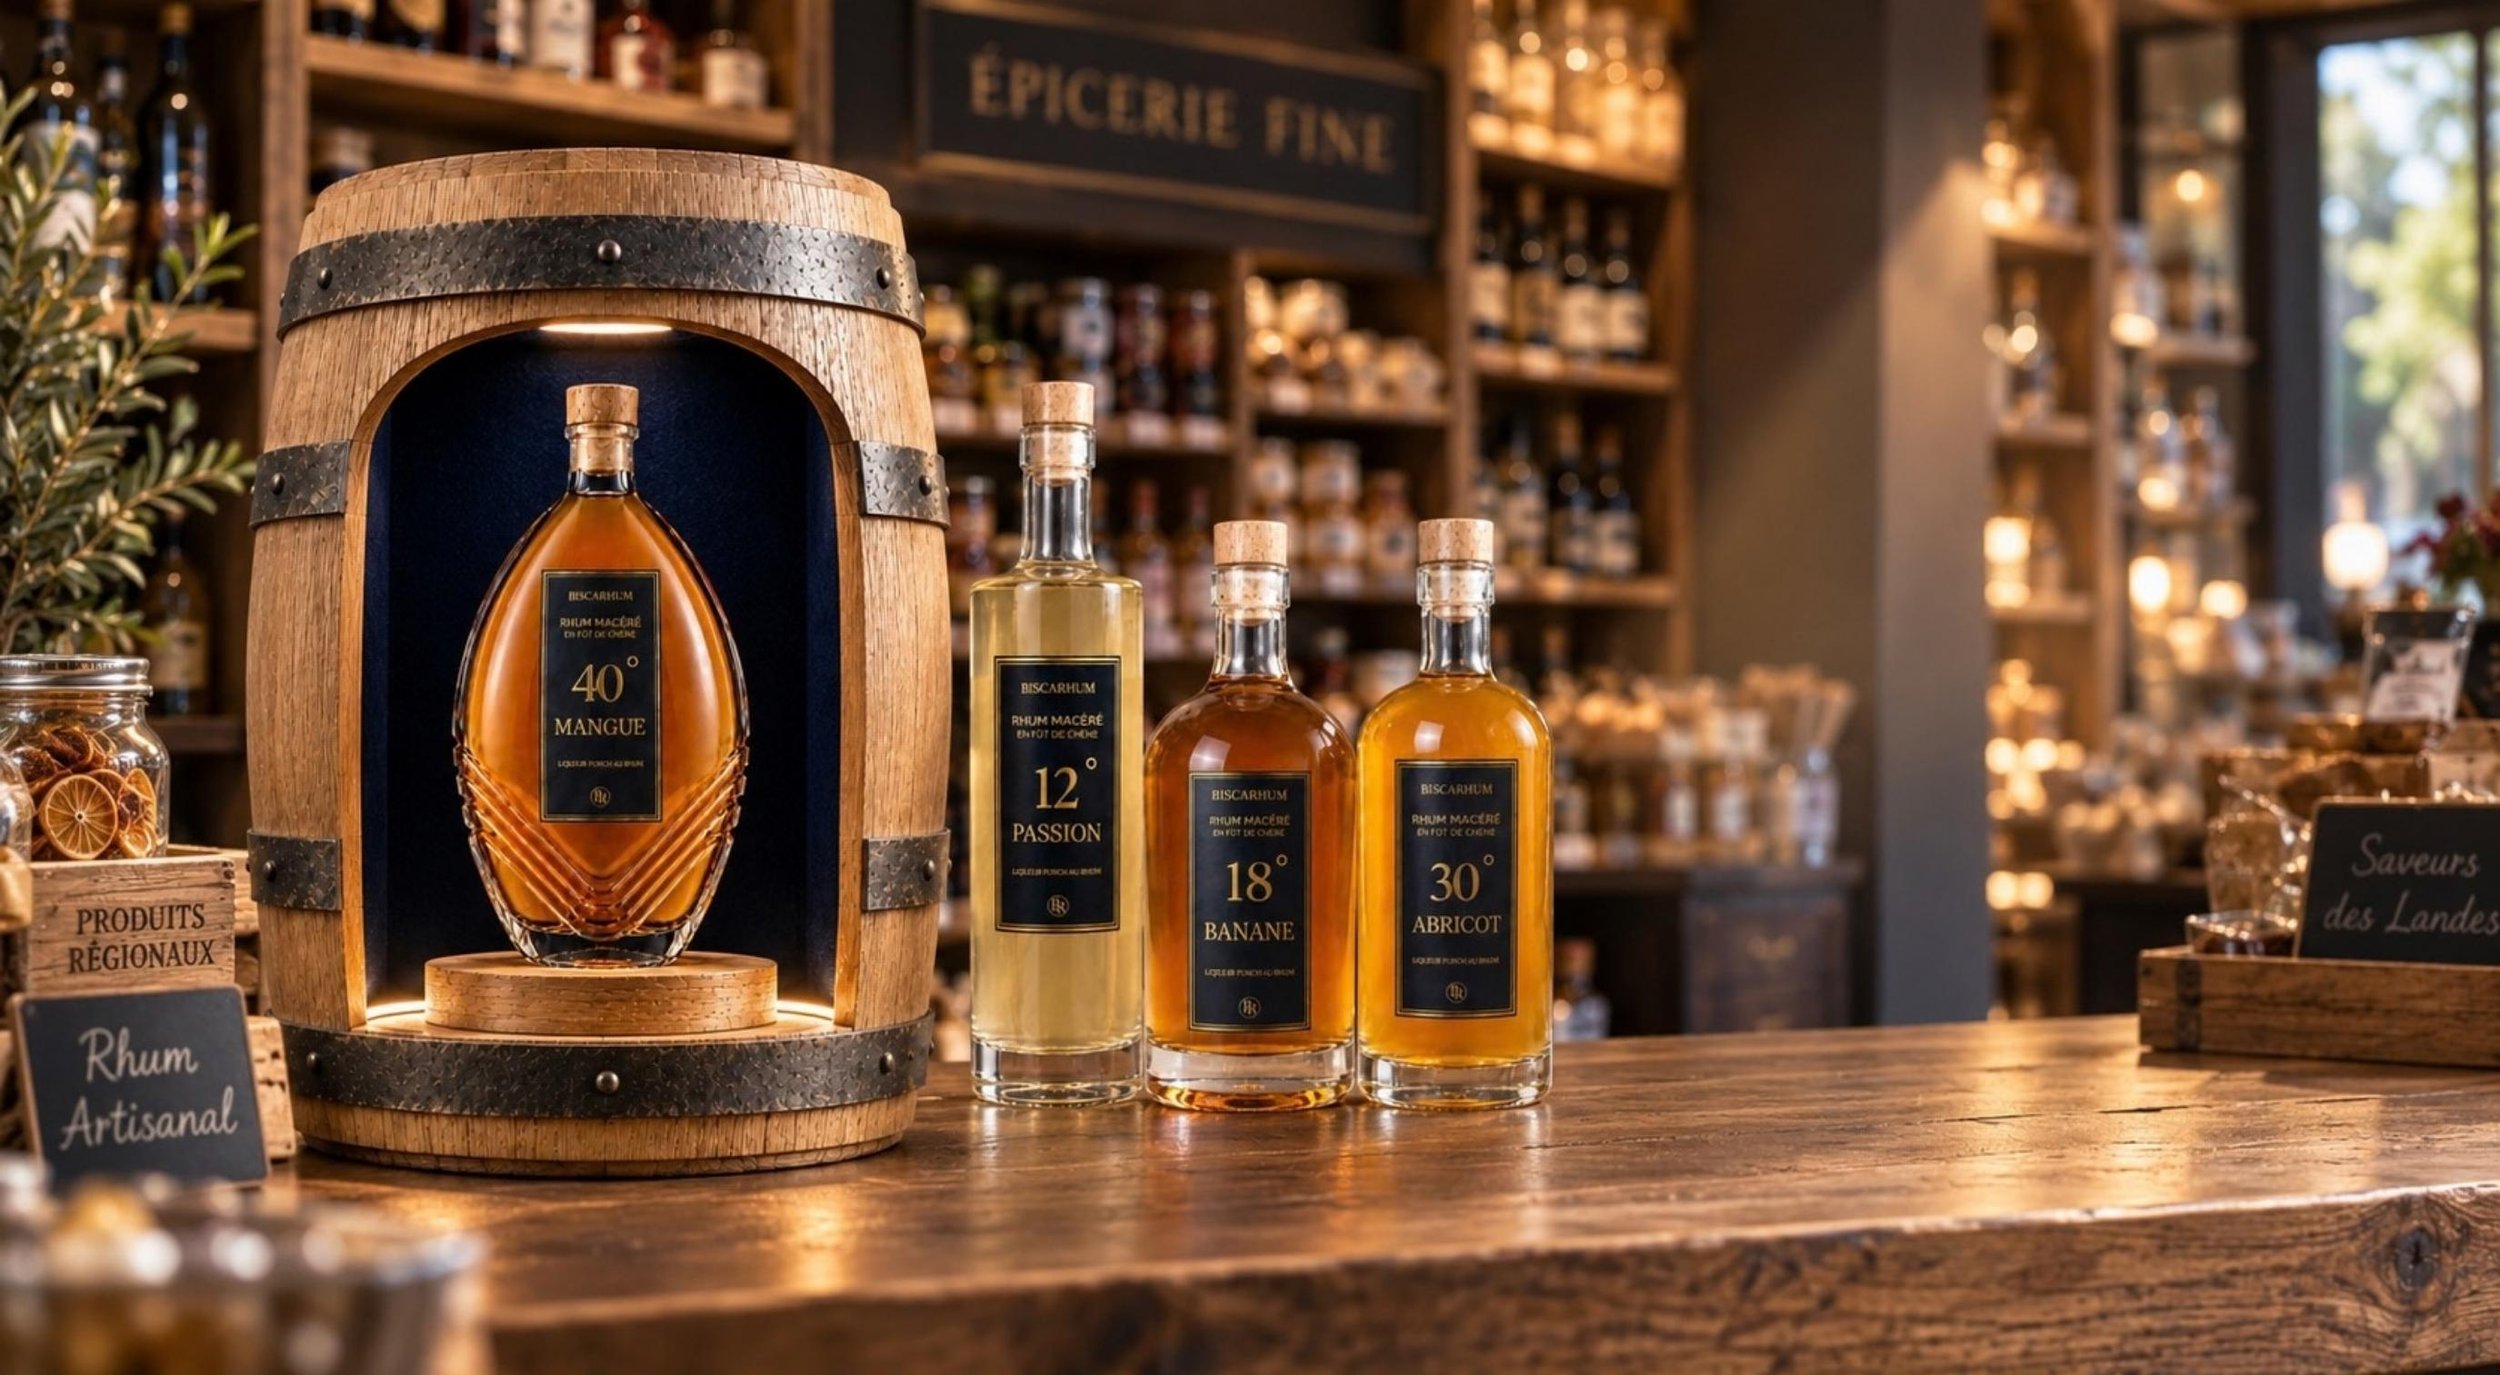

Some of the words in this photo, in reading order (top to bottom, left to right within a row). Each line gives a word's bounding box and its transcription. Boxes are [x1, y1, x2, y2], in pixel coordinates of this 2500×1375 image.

[970, 40, 1240, 149] ÉPICERIE
[1264, 96, 1396, 174] FINE
[568, 590, 633, 602] BISCARHUM
[560, 617, 592, 628] RHUM
[1021, 682, 1096, 694] BISCARHUM
[555, 717, 646, 736] MANGUE
[1012, 715, 1048, 726] RHUM
[1050, 712, 1104, 727] MACÉRÉ
[1035, 757, 1097, 809] 12°
[1421, 783, 1494, 796] BISCARHUM
[1211, 788, 1288, 801] BISCARHUM
[1209, 816, 1241, 826] RHUM
[1412, 814, 1446, 826] RHUM
[1011, 822, 1102, 843] PASSION
[2351, 832, 2480, 878] Saveurs
[76, 903, 205, 936] PRODUITS
[2323, 891, 2375, 931] des
[2384, 890, 2500, 935] Landes
[1204, 922, 1295, 941] BANANE
[1412, 915, 1502, 934] ABRICOT
[68, 939, 216, 974] RÉGIONAUX
[78, 1026, 198, 1083] Rhum
[59, 1086, 238, 1151] Artisanal
